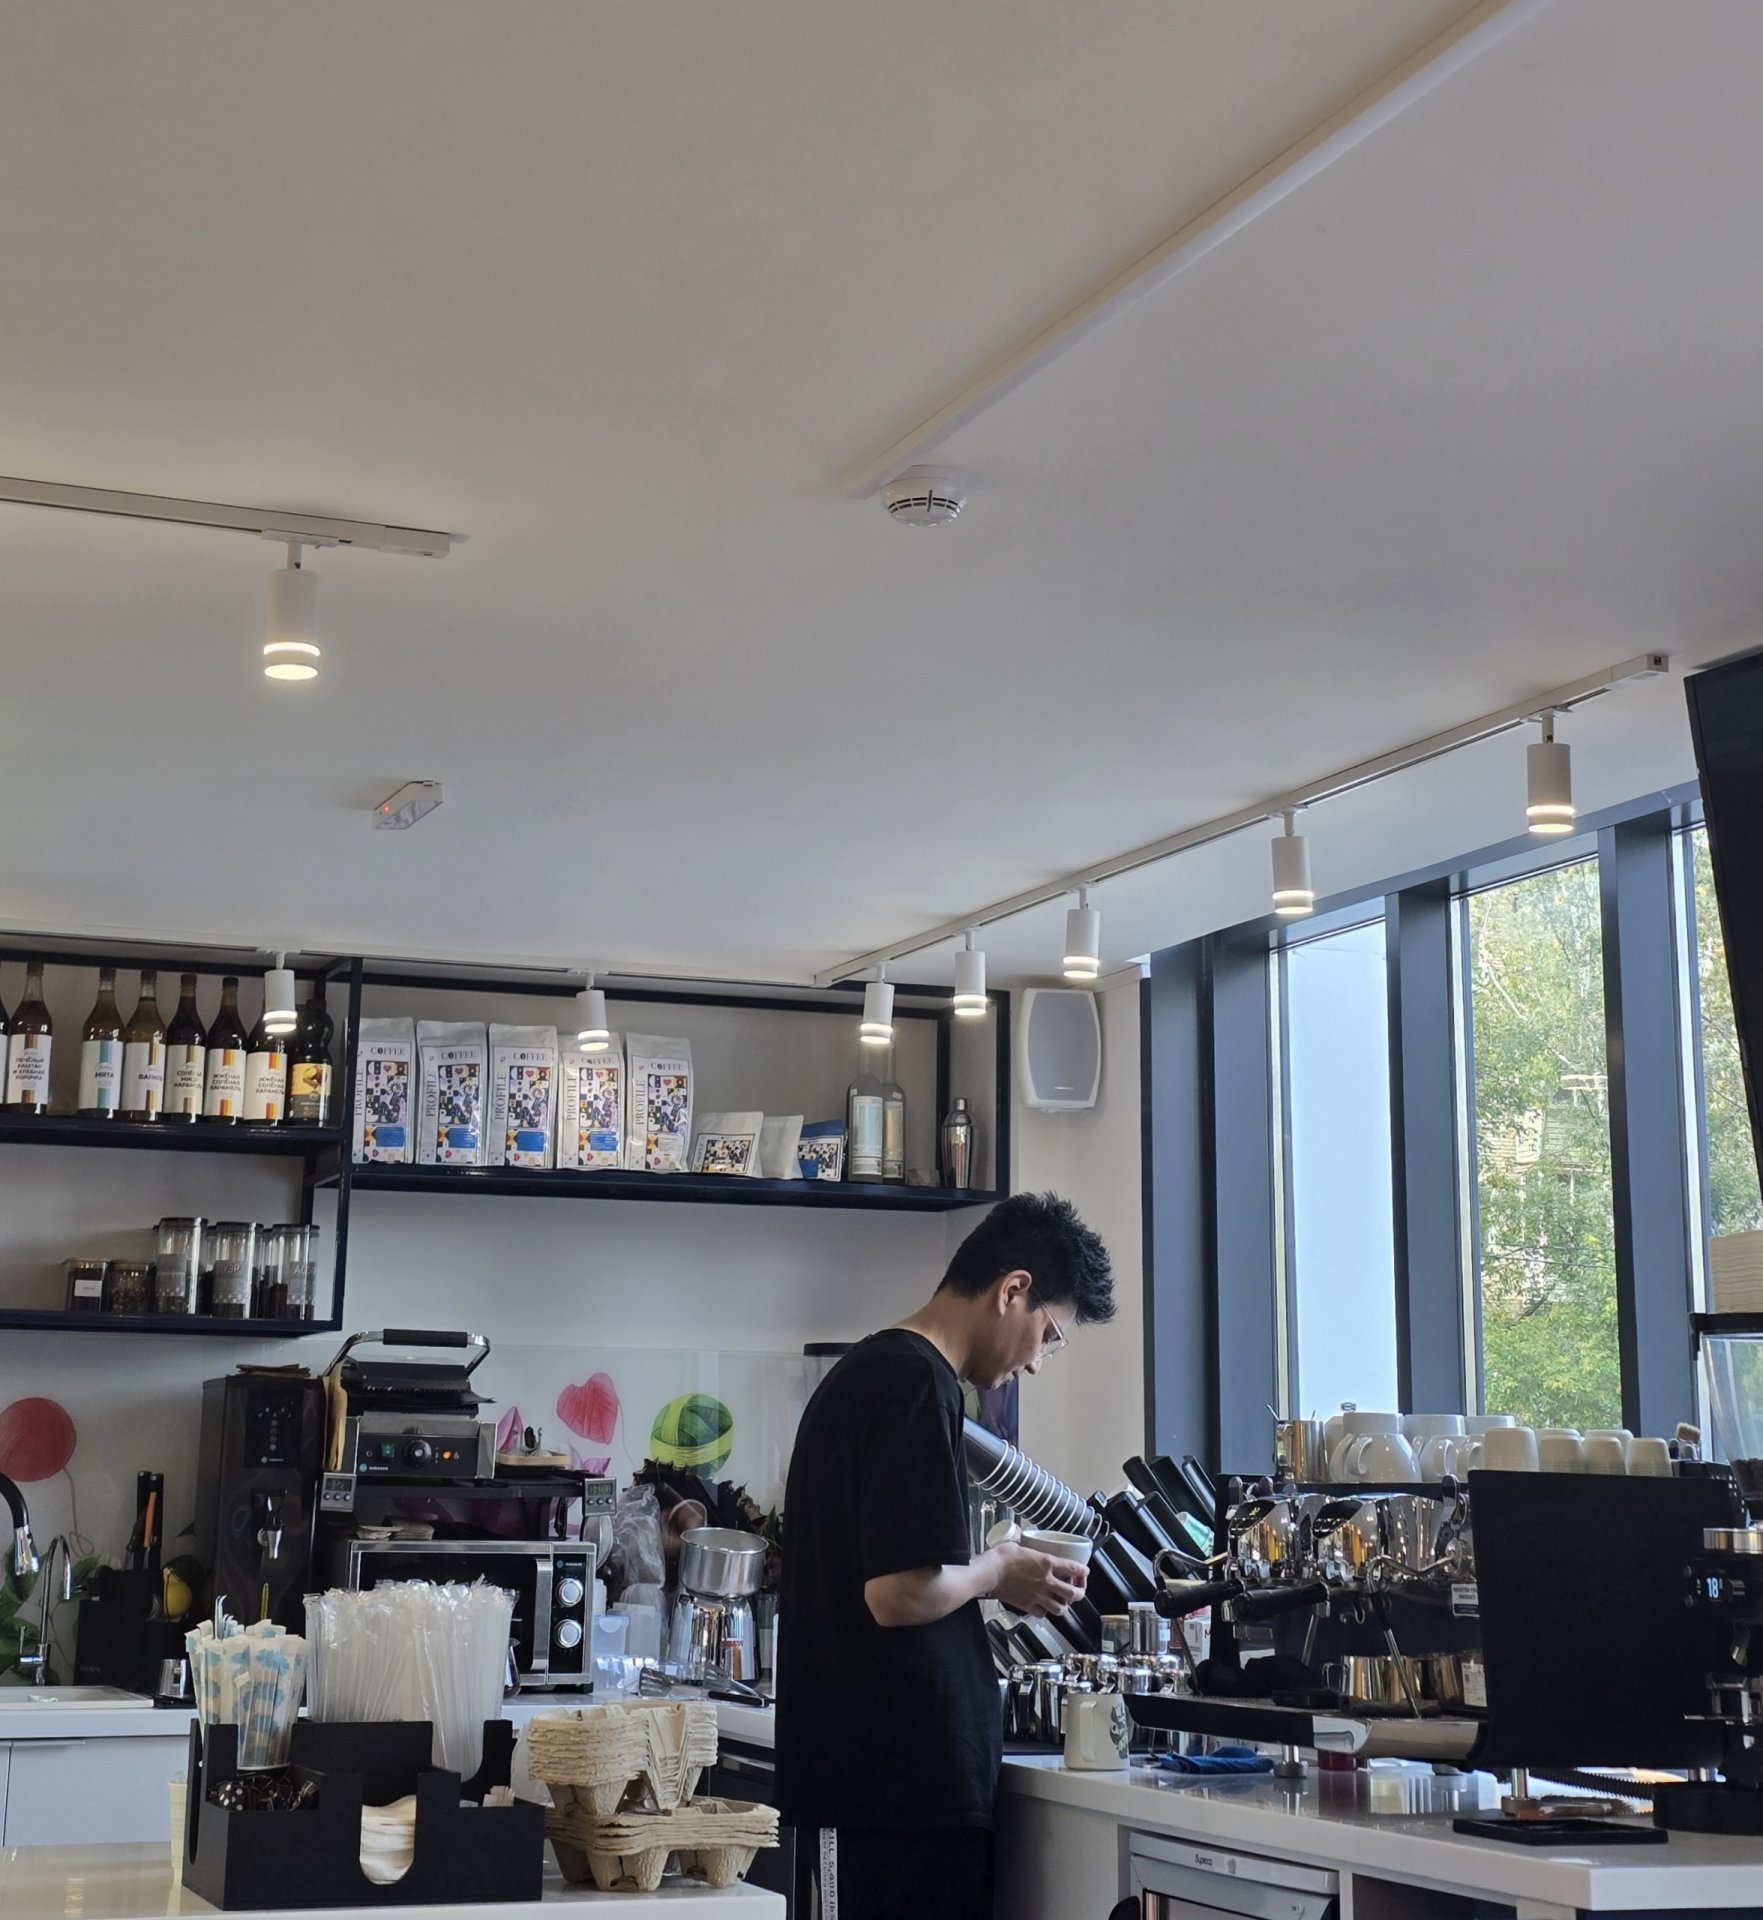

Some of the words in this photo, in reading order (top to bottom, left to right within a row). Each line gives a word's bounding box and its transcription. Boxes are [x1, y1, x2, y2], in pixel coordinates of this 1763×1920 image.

[425, 1071, 438, 1117] PROFILE
[495, 1073, 508, 1121] PROFILE
[635, 1079, 647, 1126] PROFILE
[1706, 1577, 1719, 1599] 18
